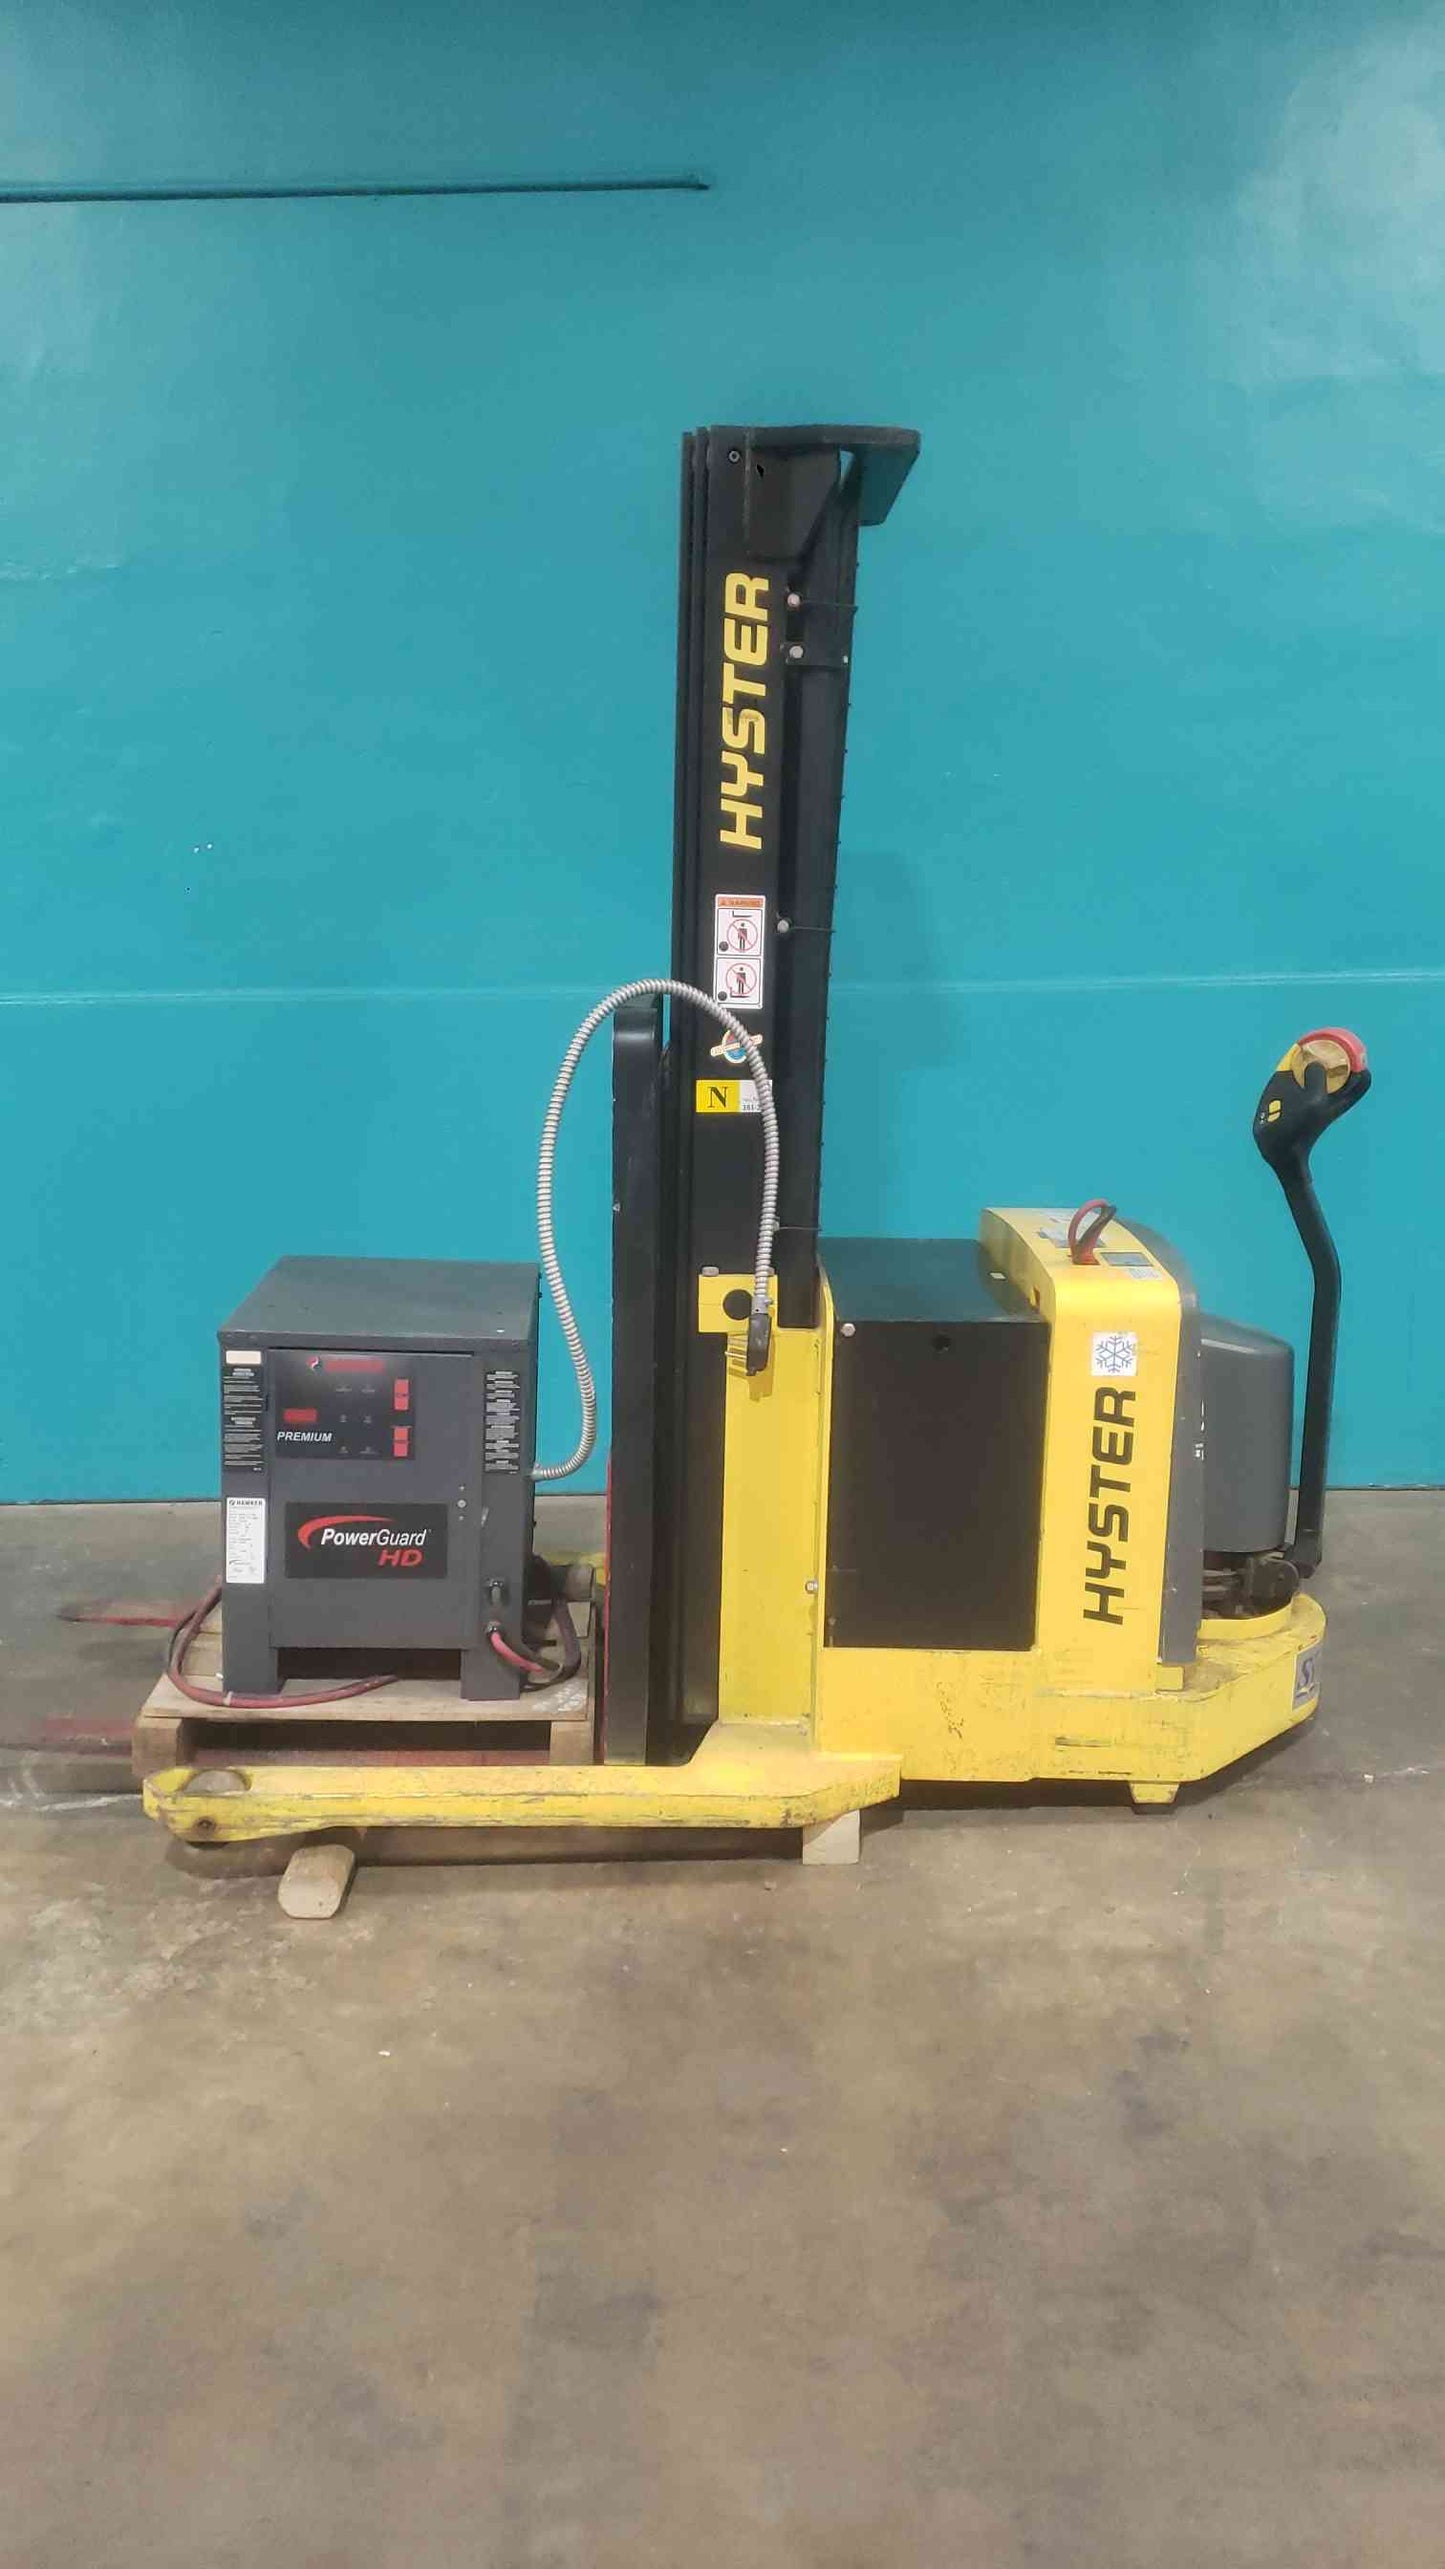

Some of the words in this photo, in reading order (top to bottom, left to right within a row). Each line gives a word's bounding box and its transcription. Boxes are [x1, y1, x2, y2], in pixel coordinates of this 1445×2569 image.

[720, 572, 769, 850] HYSTER
[707, 1086, 728, 1108] N
[277, 1431, 332, 1442] PREMIUM
[1083, 1386, 1136, 1625] HYSTER
[321, 1528, 427, 1546] PowerGuard
[377, 1549, 423, 1567] HD
